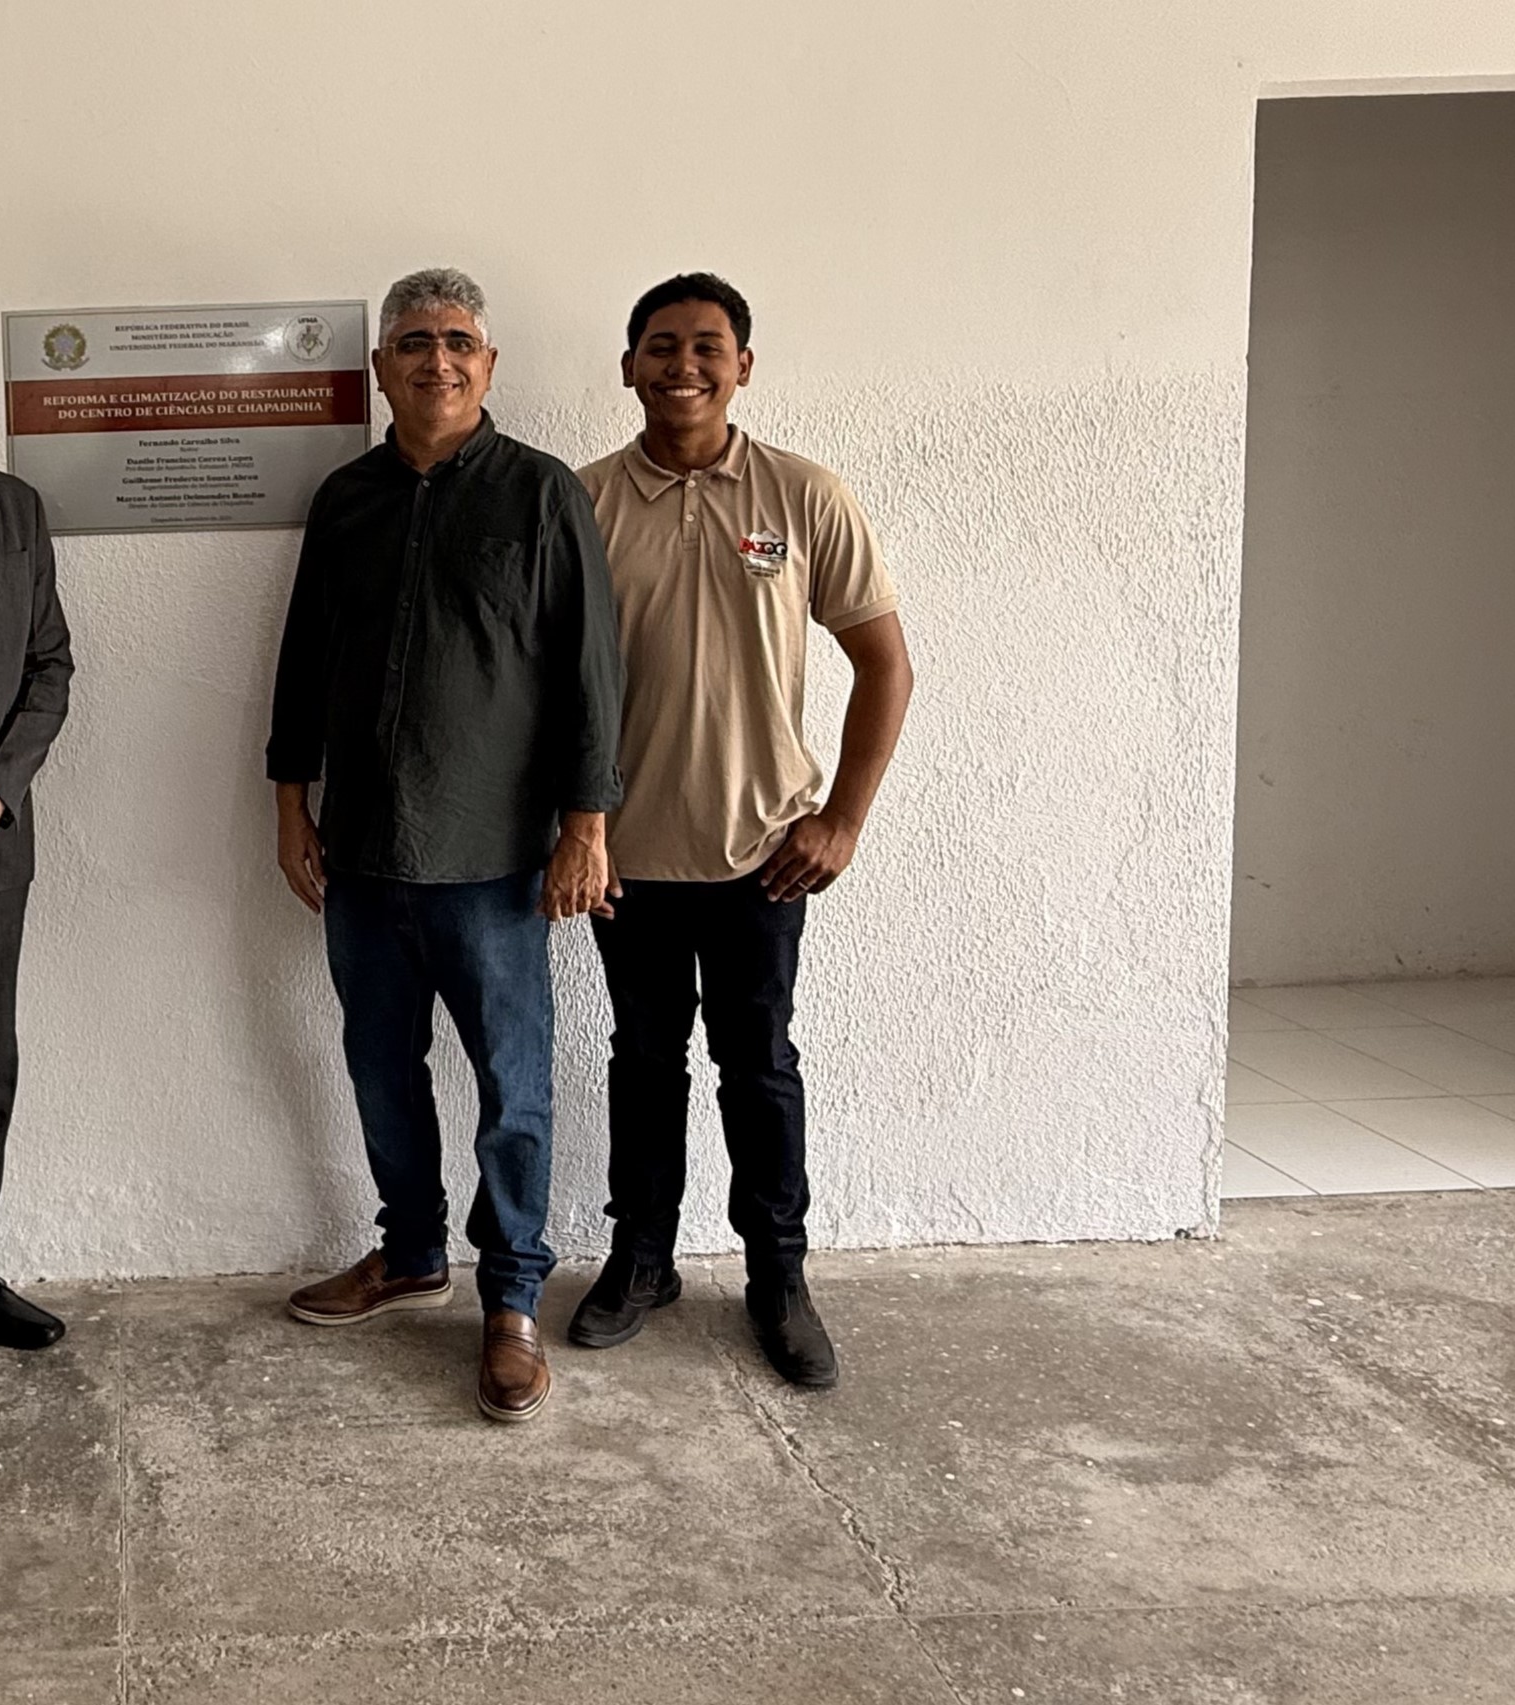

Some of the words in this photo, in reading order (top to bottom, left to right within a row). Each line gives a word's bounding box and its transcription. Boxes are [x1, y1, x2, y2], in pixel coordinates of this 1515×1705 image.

[209, 322, 221, 330] DO
[222, 321, 250, 329] BRASIL
[179, 332, 191, 340] DA
[109, 342, 167, 351] UNIVERSIDADE
[169, 341, 204, 350] FEDERAL
[43, 394, 107, 406] REFORMA
[109, 394, 118, 404] E
[120, 389, 216, 404] CLIMATIZAÇÃO
[219, 390, 238, 400] DO
[241, 387, 334, 400] RESTAURANTE
[58, 409, 77, 419] DO
[80, 407, 132, 418] CENTRO
[135, 406, 153, 417] DE
[155, 402, 214, 416] CIÊNCIAS
[217, 404, 235, 414] DE
[237, 401, 323, 413] CHAPADINHA
[139, 439, 180, 447] Fernando
[181, 438, 218, 446] Carvalho
[220, 437, 240, 445] Silva
